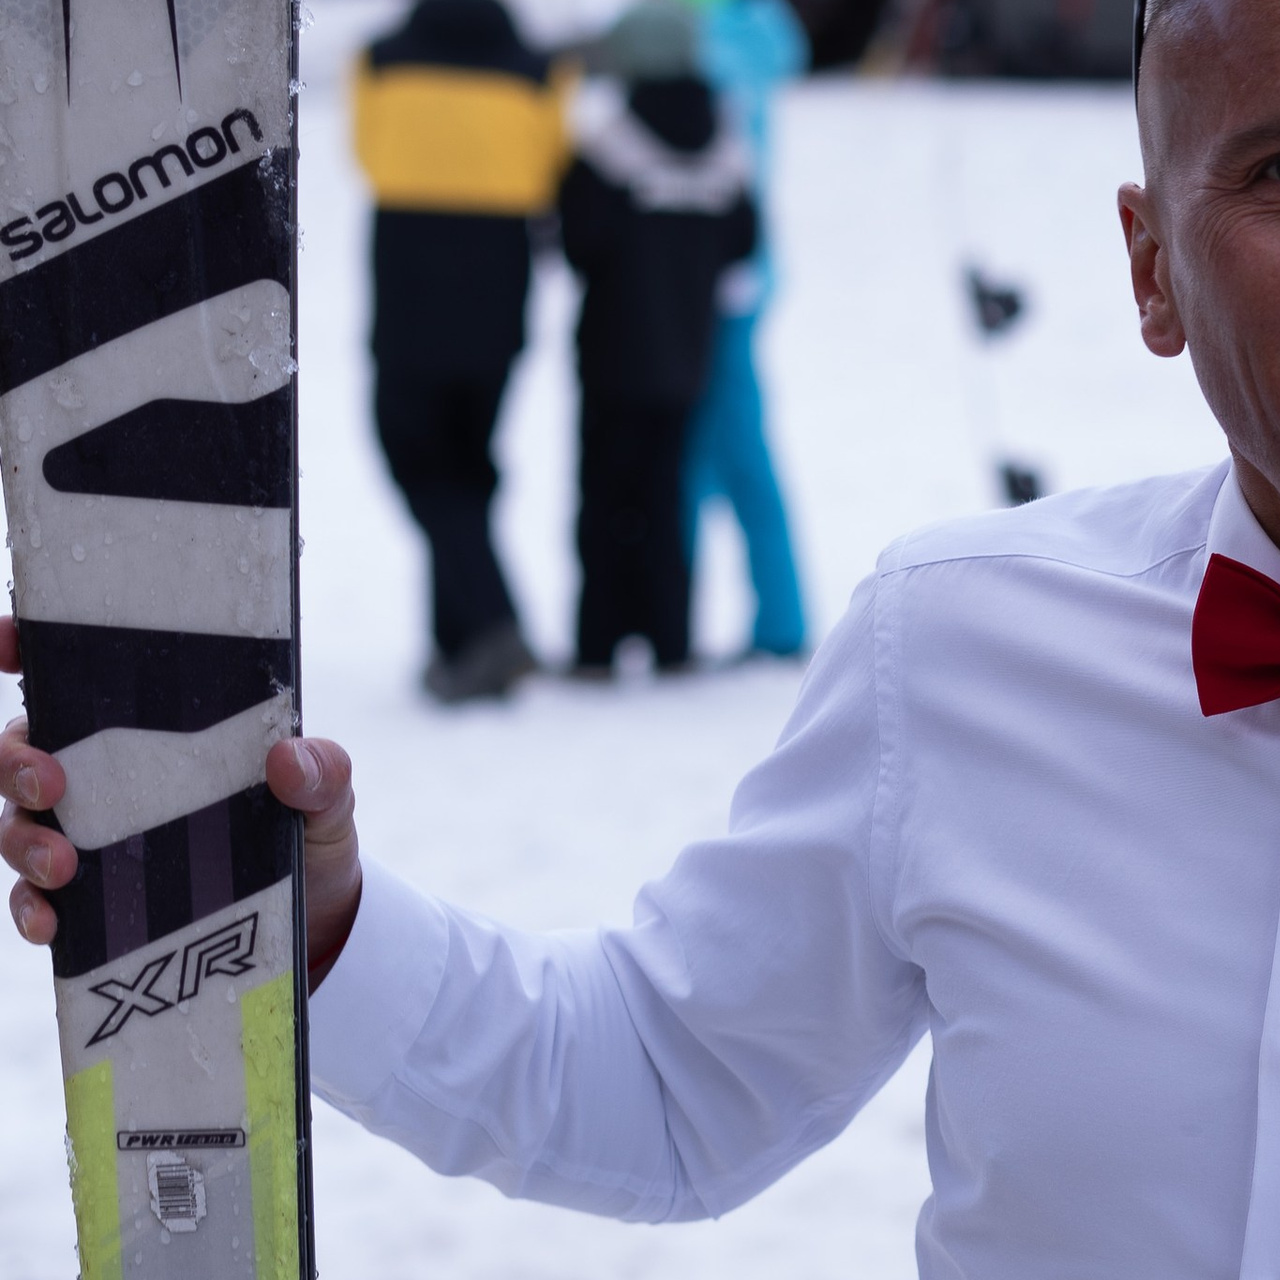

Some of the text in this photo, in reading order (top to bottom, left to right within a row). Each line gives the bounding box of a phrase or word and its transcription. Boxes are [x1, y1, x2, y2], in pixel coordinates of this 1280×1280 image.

[0, 107, 264, 262] salomon
[84, 911, 259, 1049] XR
[126, 1134, 175, 1147] PWR
